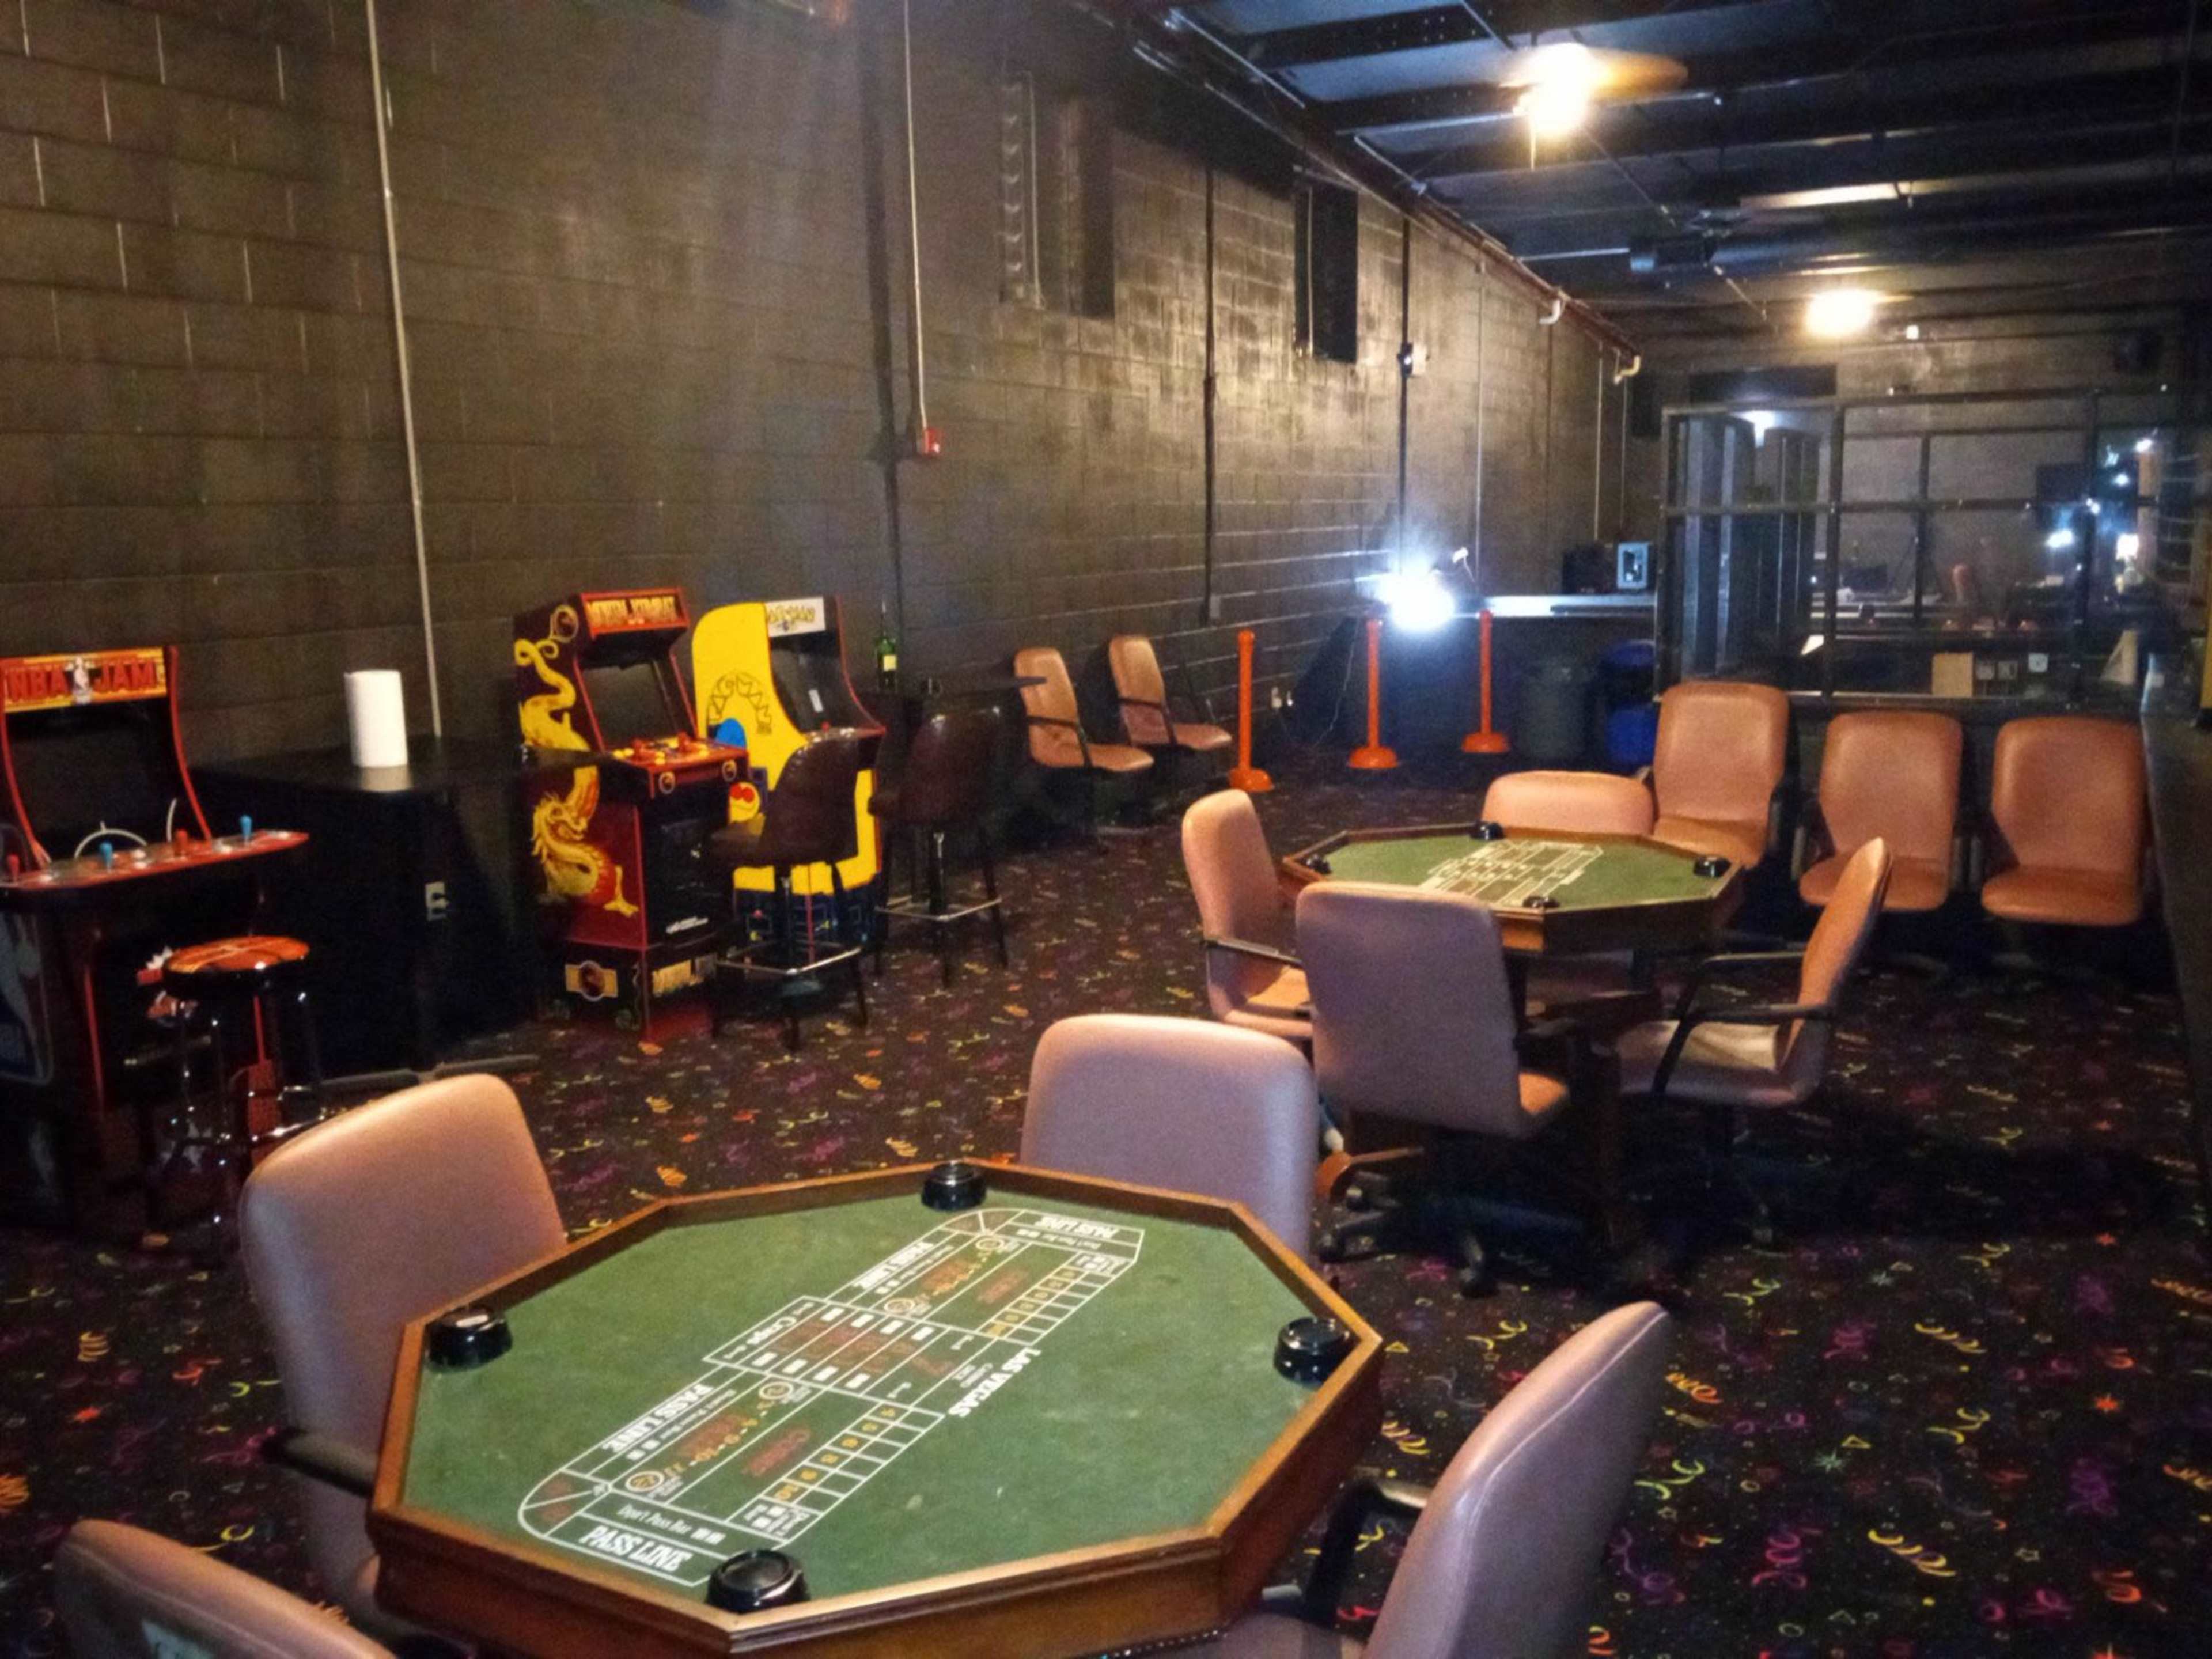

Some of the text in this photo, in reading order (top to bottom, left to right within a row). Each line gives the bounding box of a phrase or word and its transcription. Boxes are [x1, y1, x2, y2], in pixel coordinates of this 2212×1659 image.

[5, 657, 157, 704] NBA JAM
[1001, 1347, 1042, 1373] LAS
[578, 1524, 694, 1572] PASS LINE
